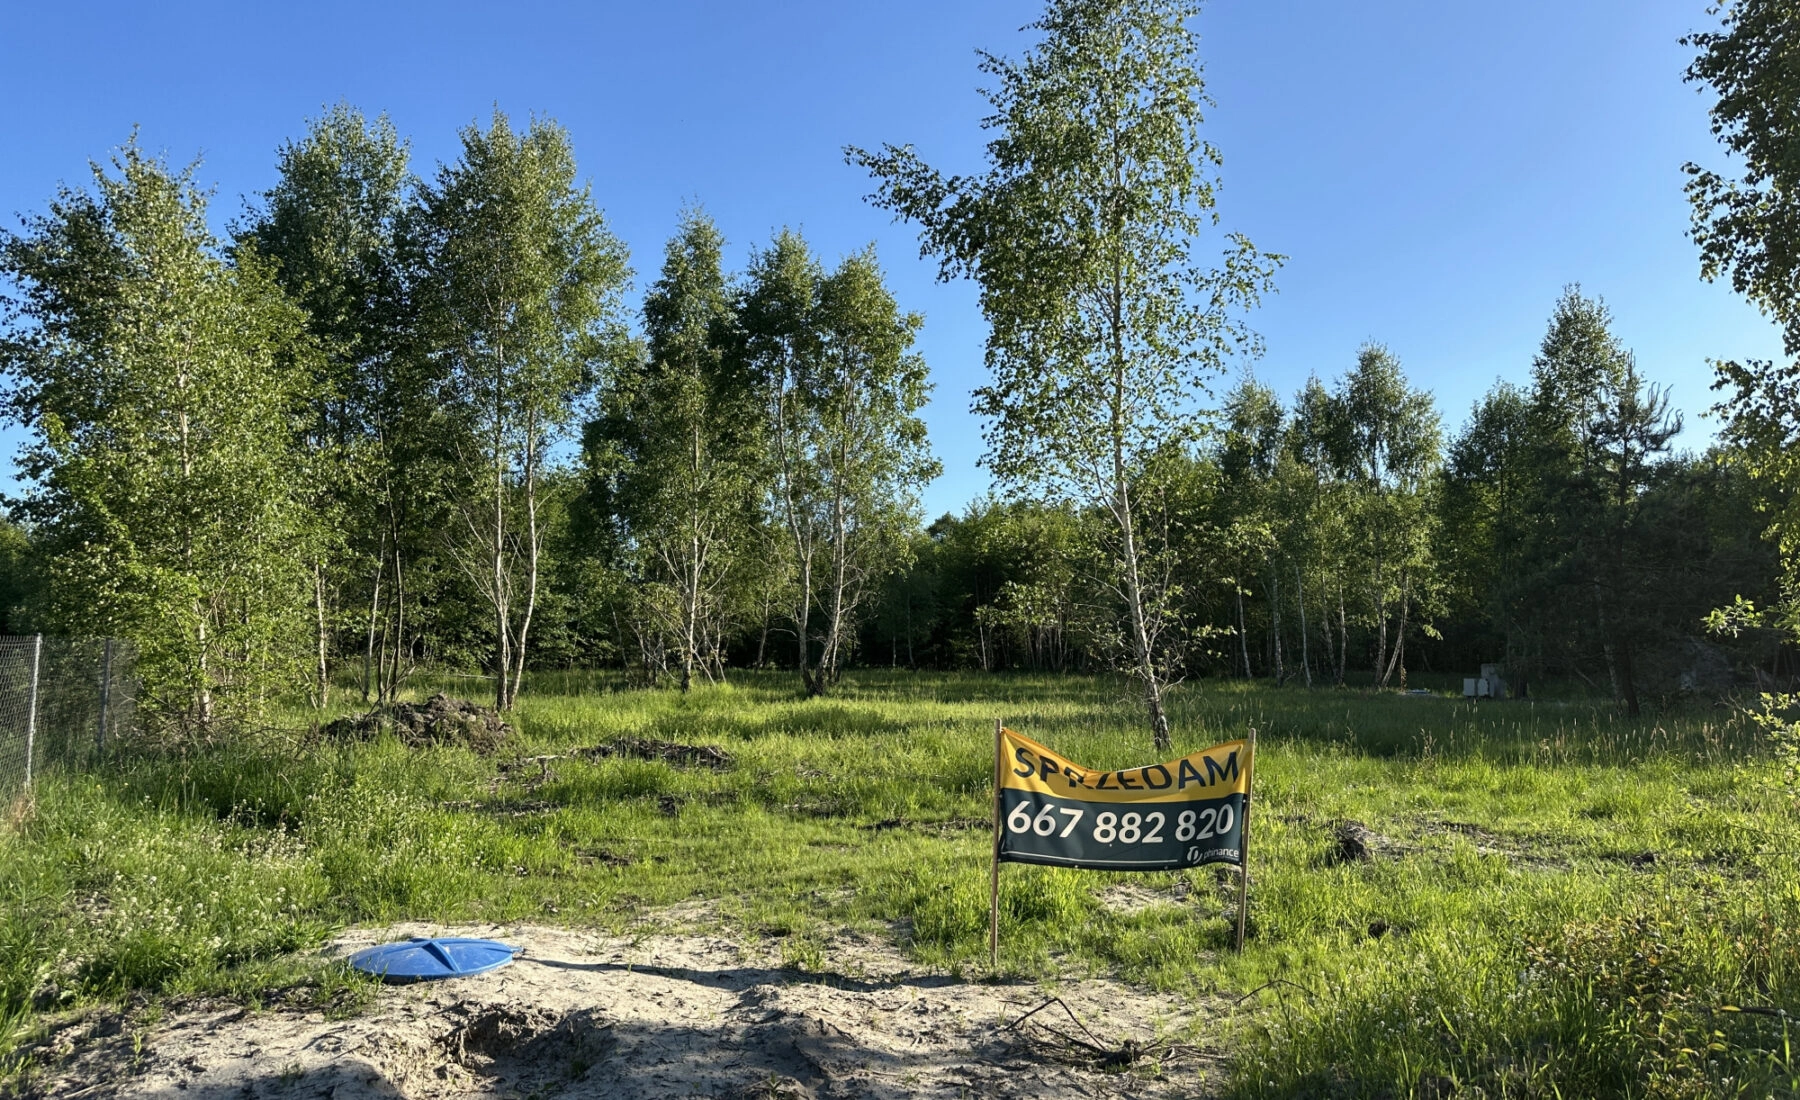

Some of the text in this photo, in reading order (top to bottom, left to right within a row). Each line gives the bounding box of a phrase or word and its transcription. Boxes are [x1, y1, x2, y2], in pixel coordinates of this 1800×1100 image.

[1013, 747, 1238, 789] SPRZEDAM
[1007, 800, 1234, 844] 667 882 820
[1203, 848, 1239, 860] phinance
